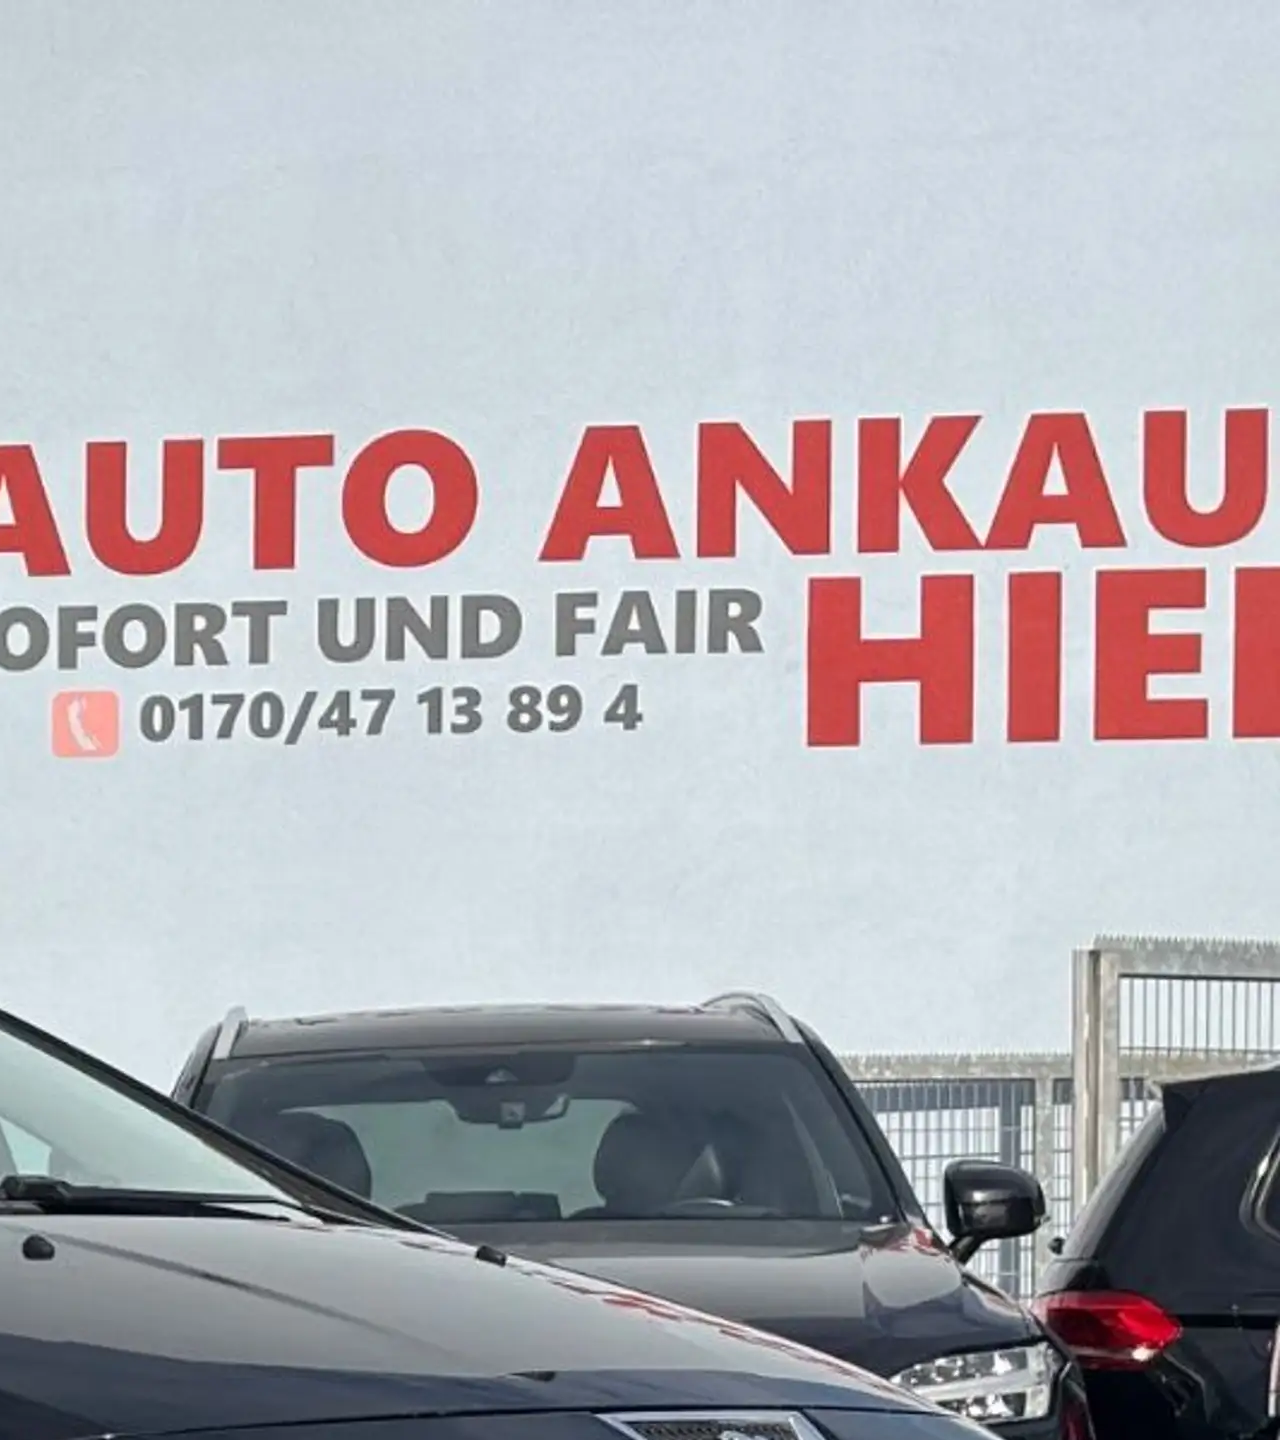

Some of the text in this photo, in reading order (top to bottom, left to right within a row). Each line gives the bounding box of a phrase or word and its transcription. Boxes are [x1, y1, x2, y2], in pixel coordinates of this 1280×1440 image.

[539, 409, 1269, 561] ANKAU
[316, 594, 524, 664] UND
[554, 588, 765, 658] FAIR
[139, 683, 644, 748] 0170/47 13 89 4
